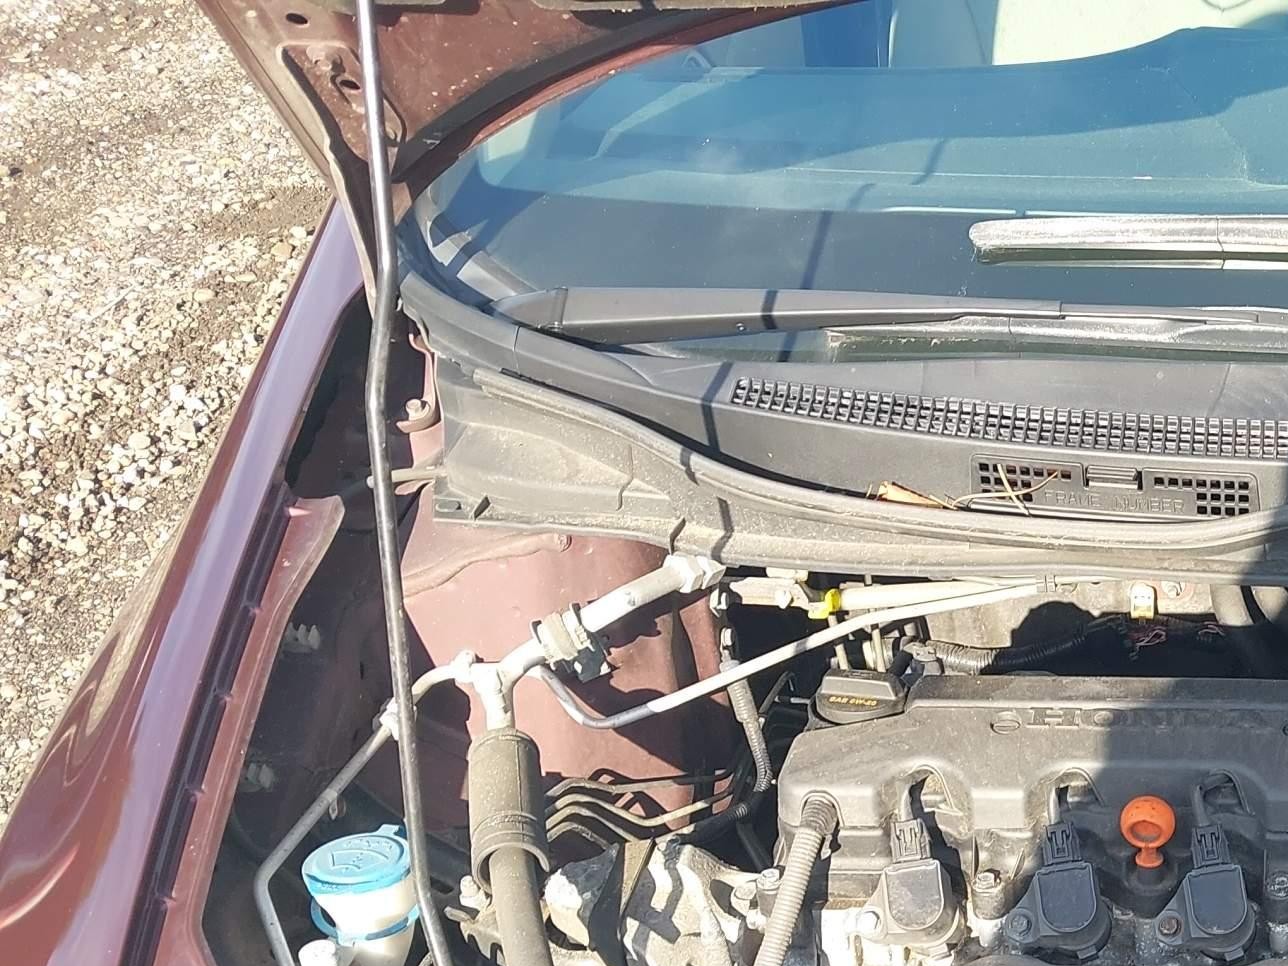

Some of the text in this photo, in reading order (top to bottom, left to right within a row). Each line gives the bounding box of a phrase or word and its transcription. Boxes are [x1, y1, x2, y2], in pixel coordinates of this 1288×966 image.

[1044, 489, 1186, 514] FRAME NUMBER
[1024, 706, 1270, 730] HONDA
